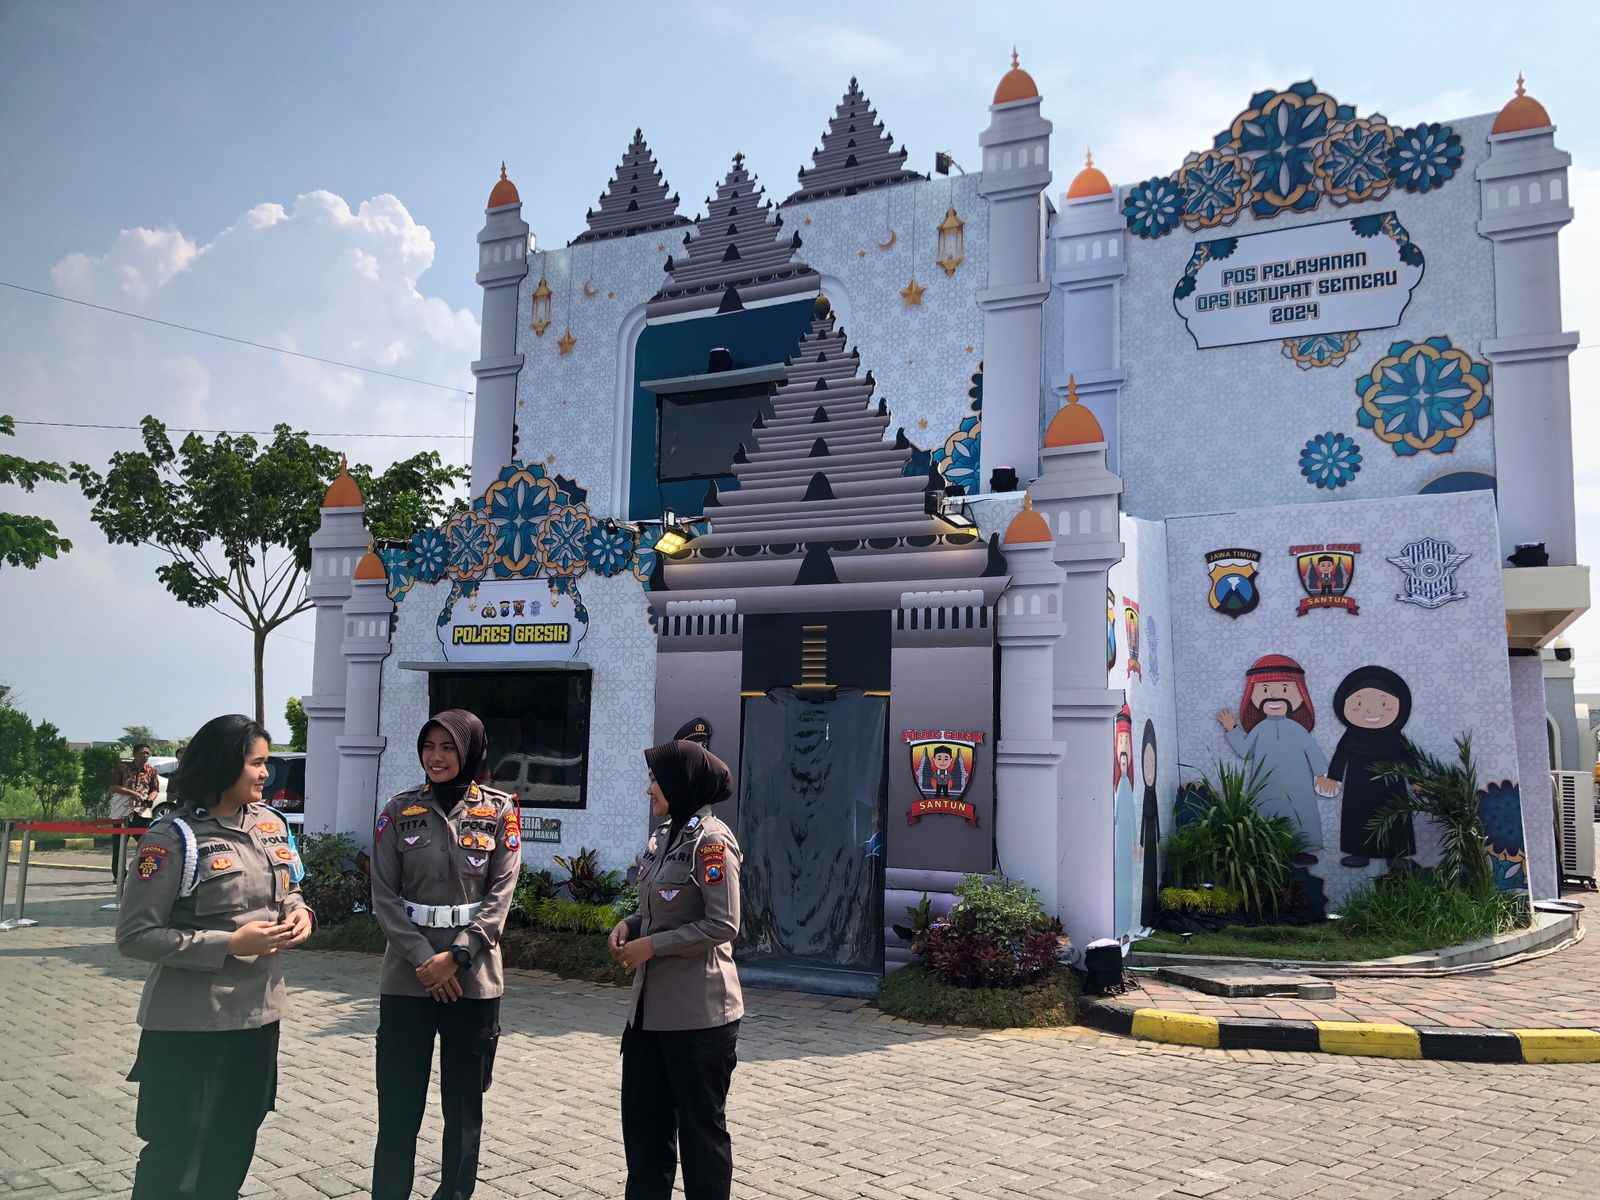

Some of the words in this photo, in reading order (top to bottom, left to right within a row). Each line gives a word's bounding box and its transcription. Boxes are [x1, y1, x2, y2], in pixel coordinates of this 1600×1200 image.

[1222, 269, 1256, 287] POS
[1262, 251, 1367, 281] PELAYANAN
[1196, 293, 1231, 312] OPS
[1235, 282, 1312, 306] KETUPAT
[1318, 270, 1399, 294] SEMERU
[1271, 303, 1320, 324] 2024
[1208, 552, 1231, 561] JAWA
[1233, 551, 1257, 560] TIMUR
[1306, 596, 1348, 606] SANTUN
[453, 625, 512, 645] POLRES
[514, 623, 570, 644] GRESIK
[919, 800, 966, 811] SANTUN
[399, 819, 427, 831] TITA
[461, 820, 496, 832] POLRI
